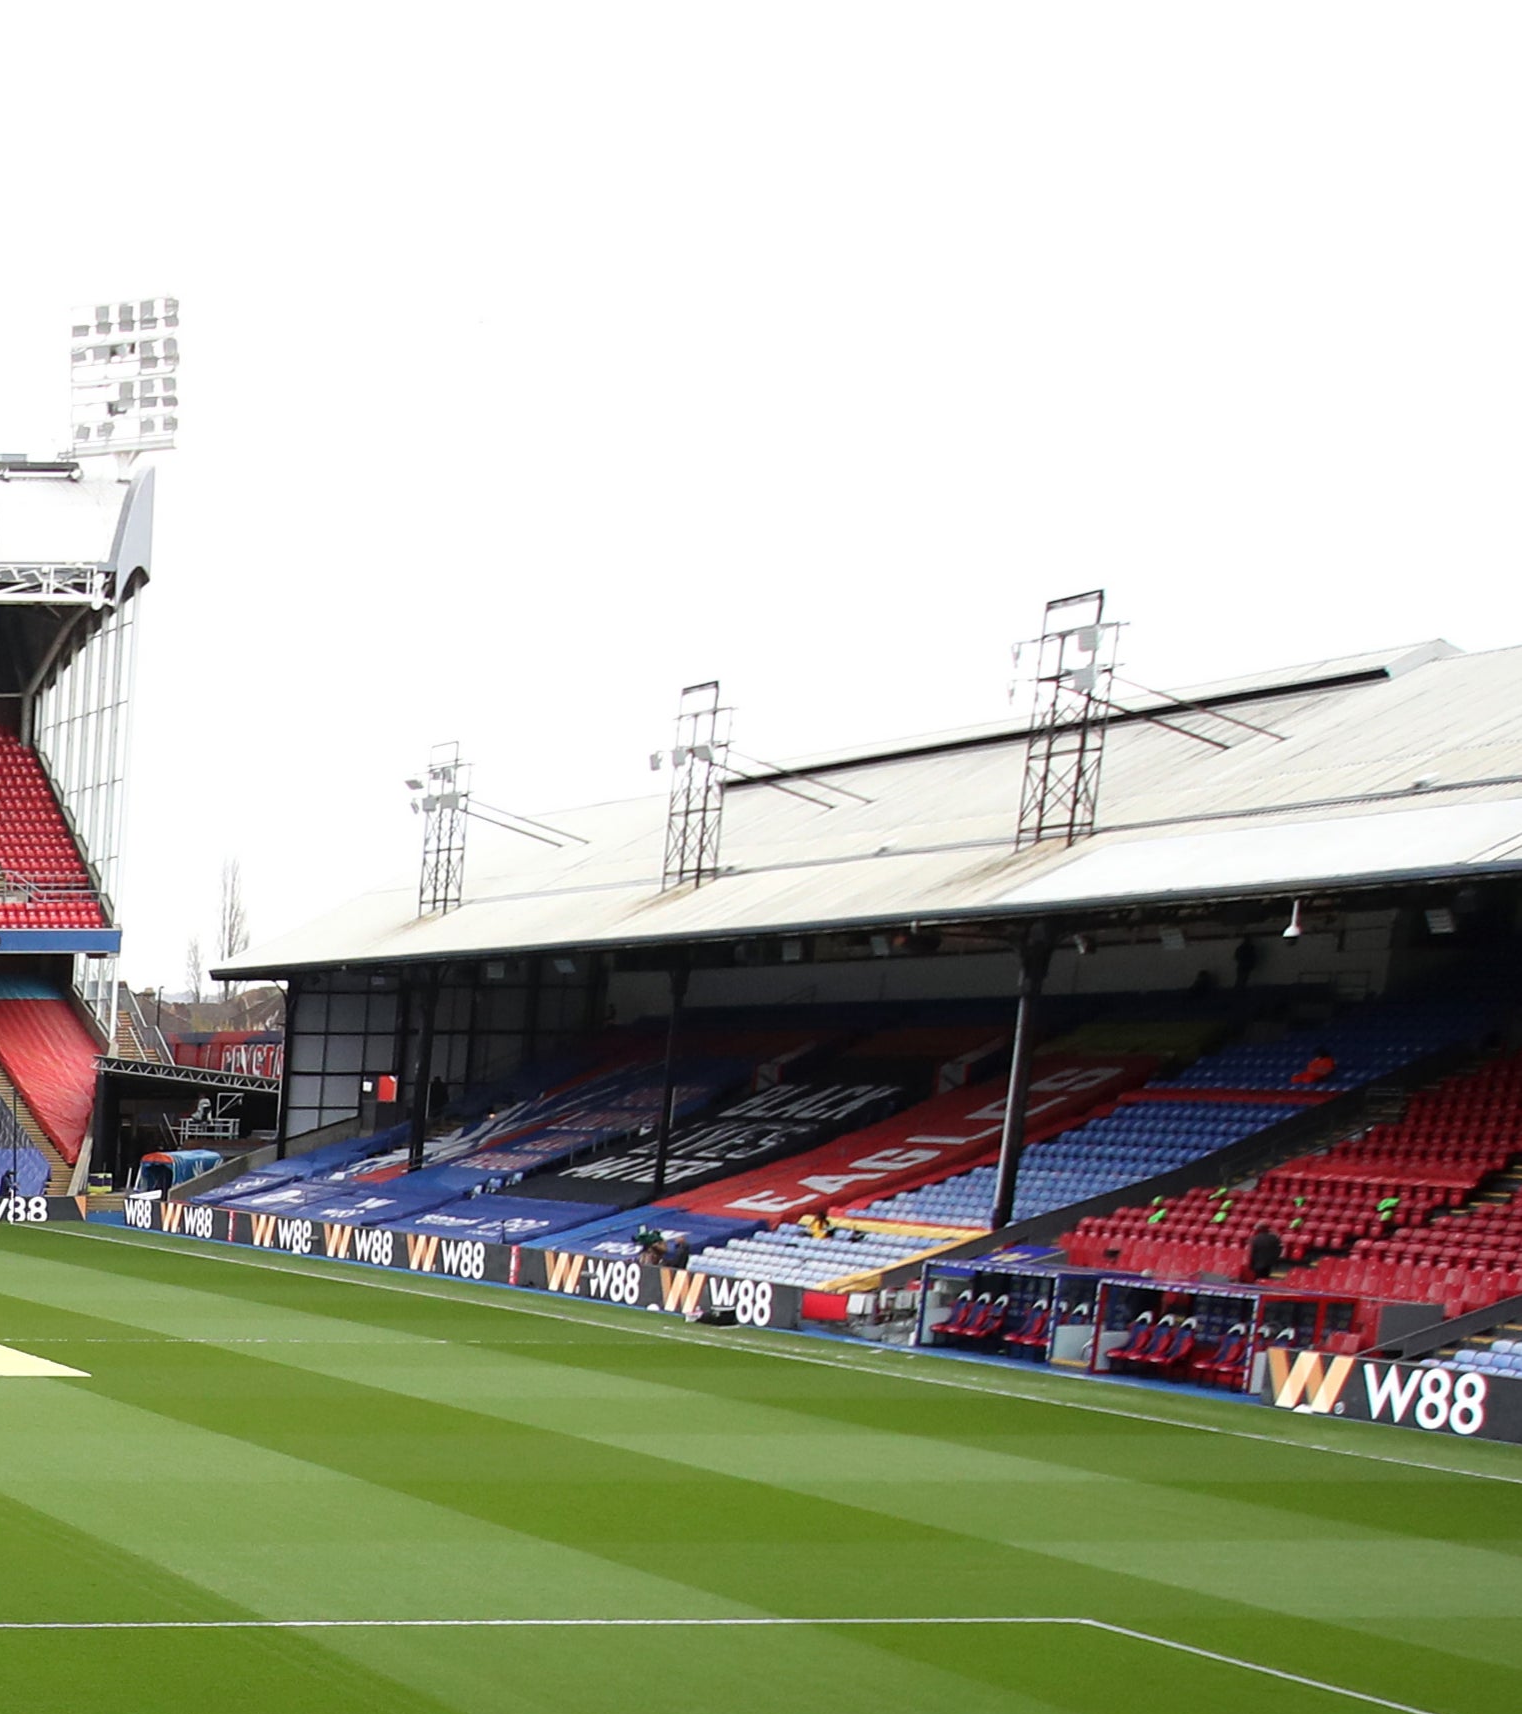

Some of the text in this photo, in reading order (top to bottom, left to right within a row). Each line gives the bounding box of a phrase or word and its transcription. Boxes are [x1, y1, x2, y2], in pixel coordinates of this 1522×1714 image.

[123, 1199, 153, 1230] W88
[183, 1204, 214, 1239] W88
[355, 1230, 393, 1267] W88
[441, 1239, 486, 1280] W88
[588, 1258, 642, 1305] W88
[709, 1277, 773, 1327] W88
[1363, 1362, 1489, 1435] W88
